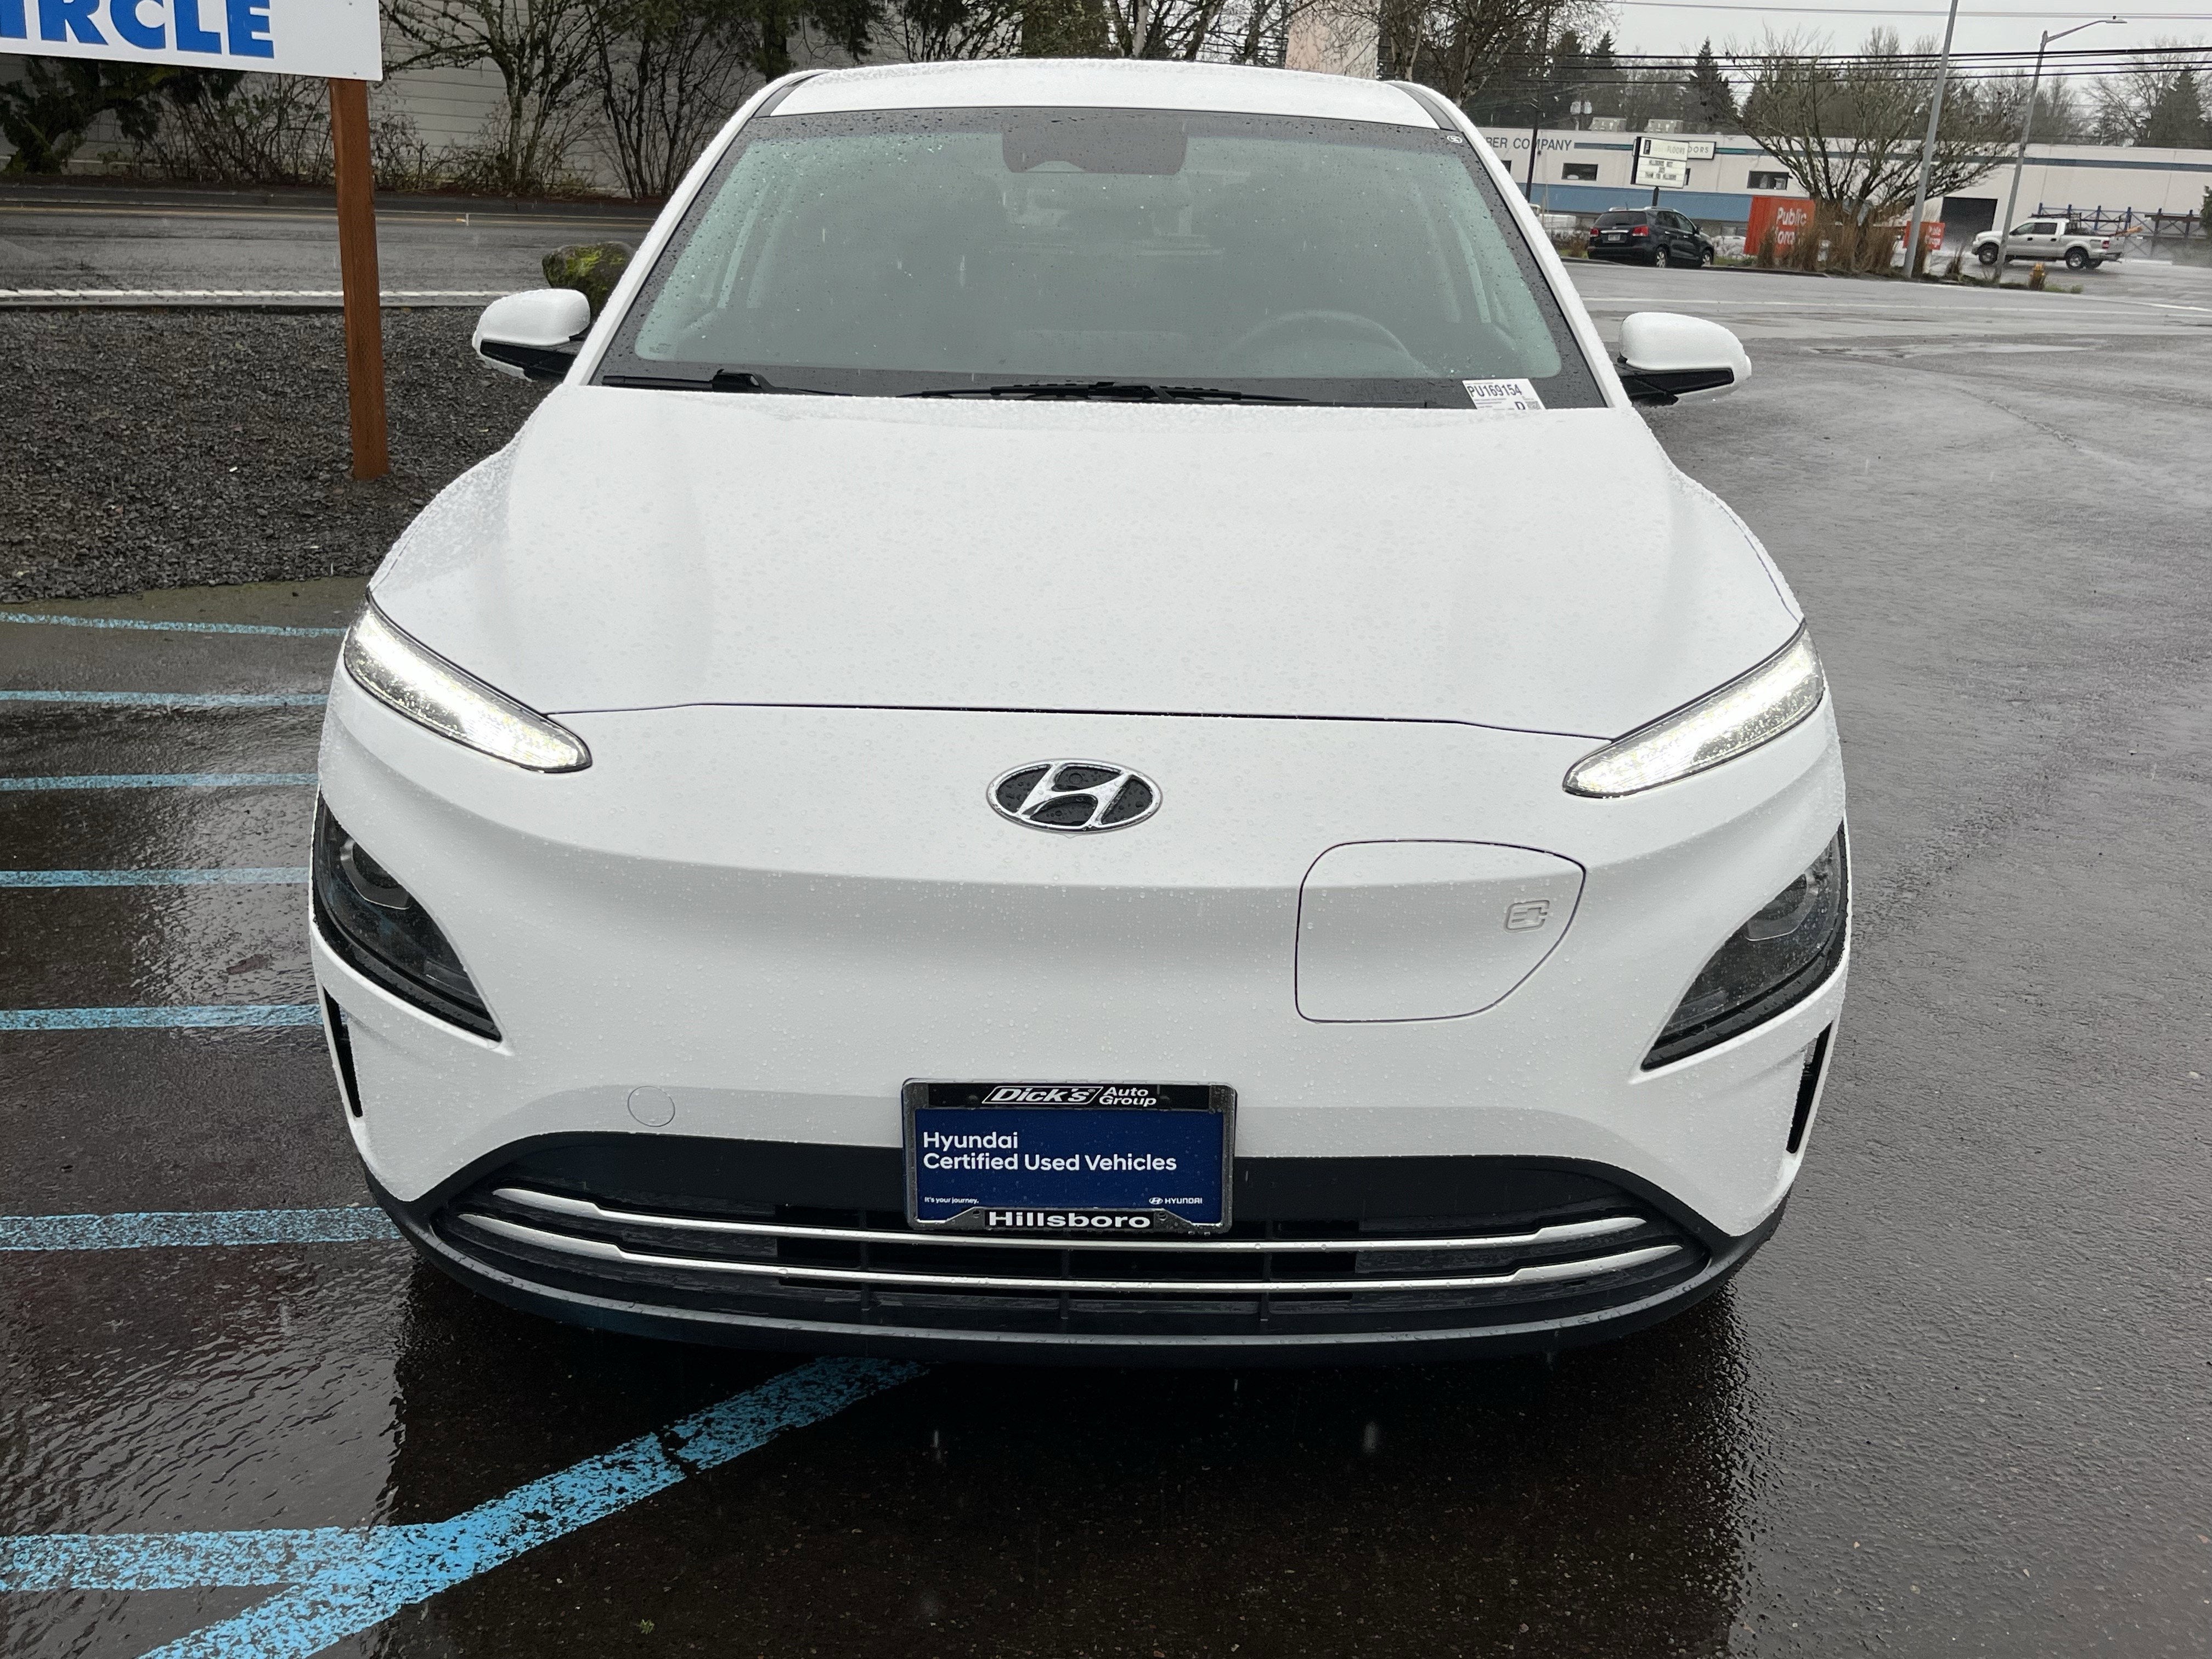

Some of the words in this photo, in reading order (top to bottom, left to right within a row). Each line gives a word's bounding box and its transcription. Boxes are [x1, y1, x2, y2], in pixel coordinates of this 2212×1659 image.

[1776, 207, 1807, 227] Public
[1466, 383, 1522, 398] PU169154
[1514, 401, 1526, 410] D
[990, 1087, 1090, 1102] Dick's
[1103, 1086, 1149, 1097] Auto
[1099, 1096, 1156, 1107] Group
[923, 1132, 1018, 1153] Hyundai
[923, 1153, 1019, 1171] Certified
[1024, 1153, 1080, 1171] Used
[1085, 1154, 1177, 1172] Vehicles
[989, 1210, 1151, 1229] Hillsboro
